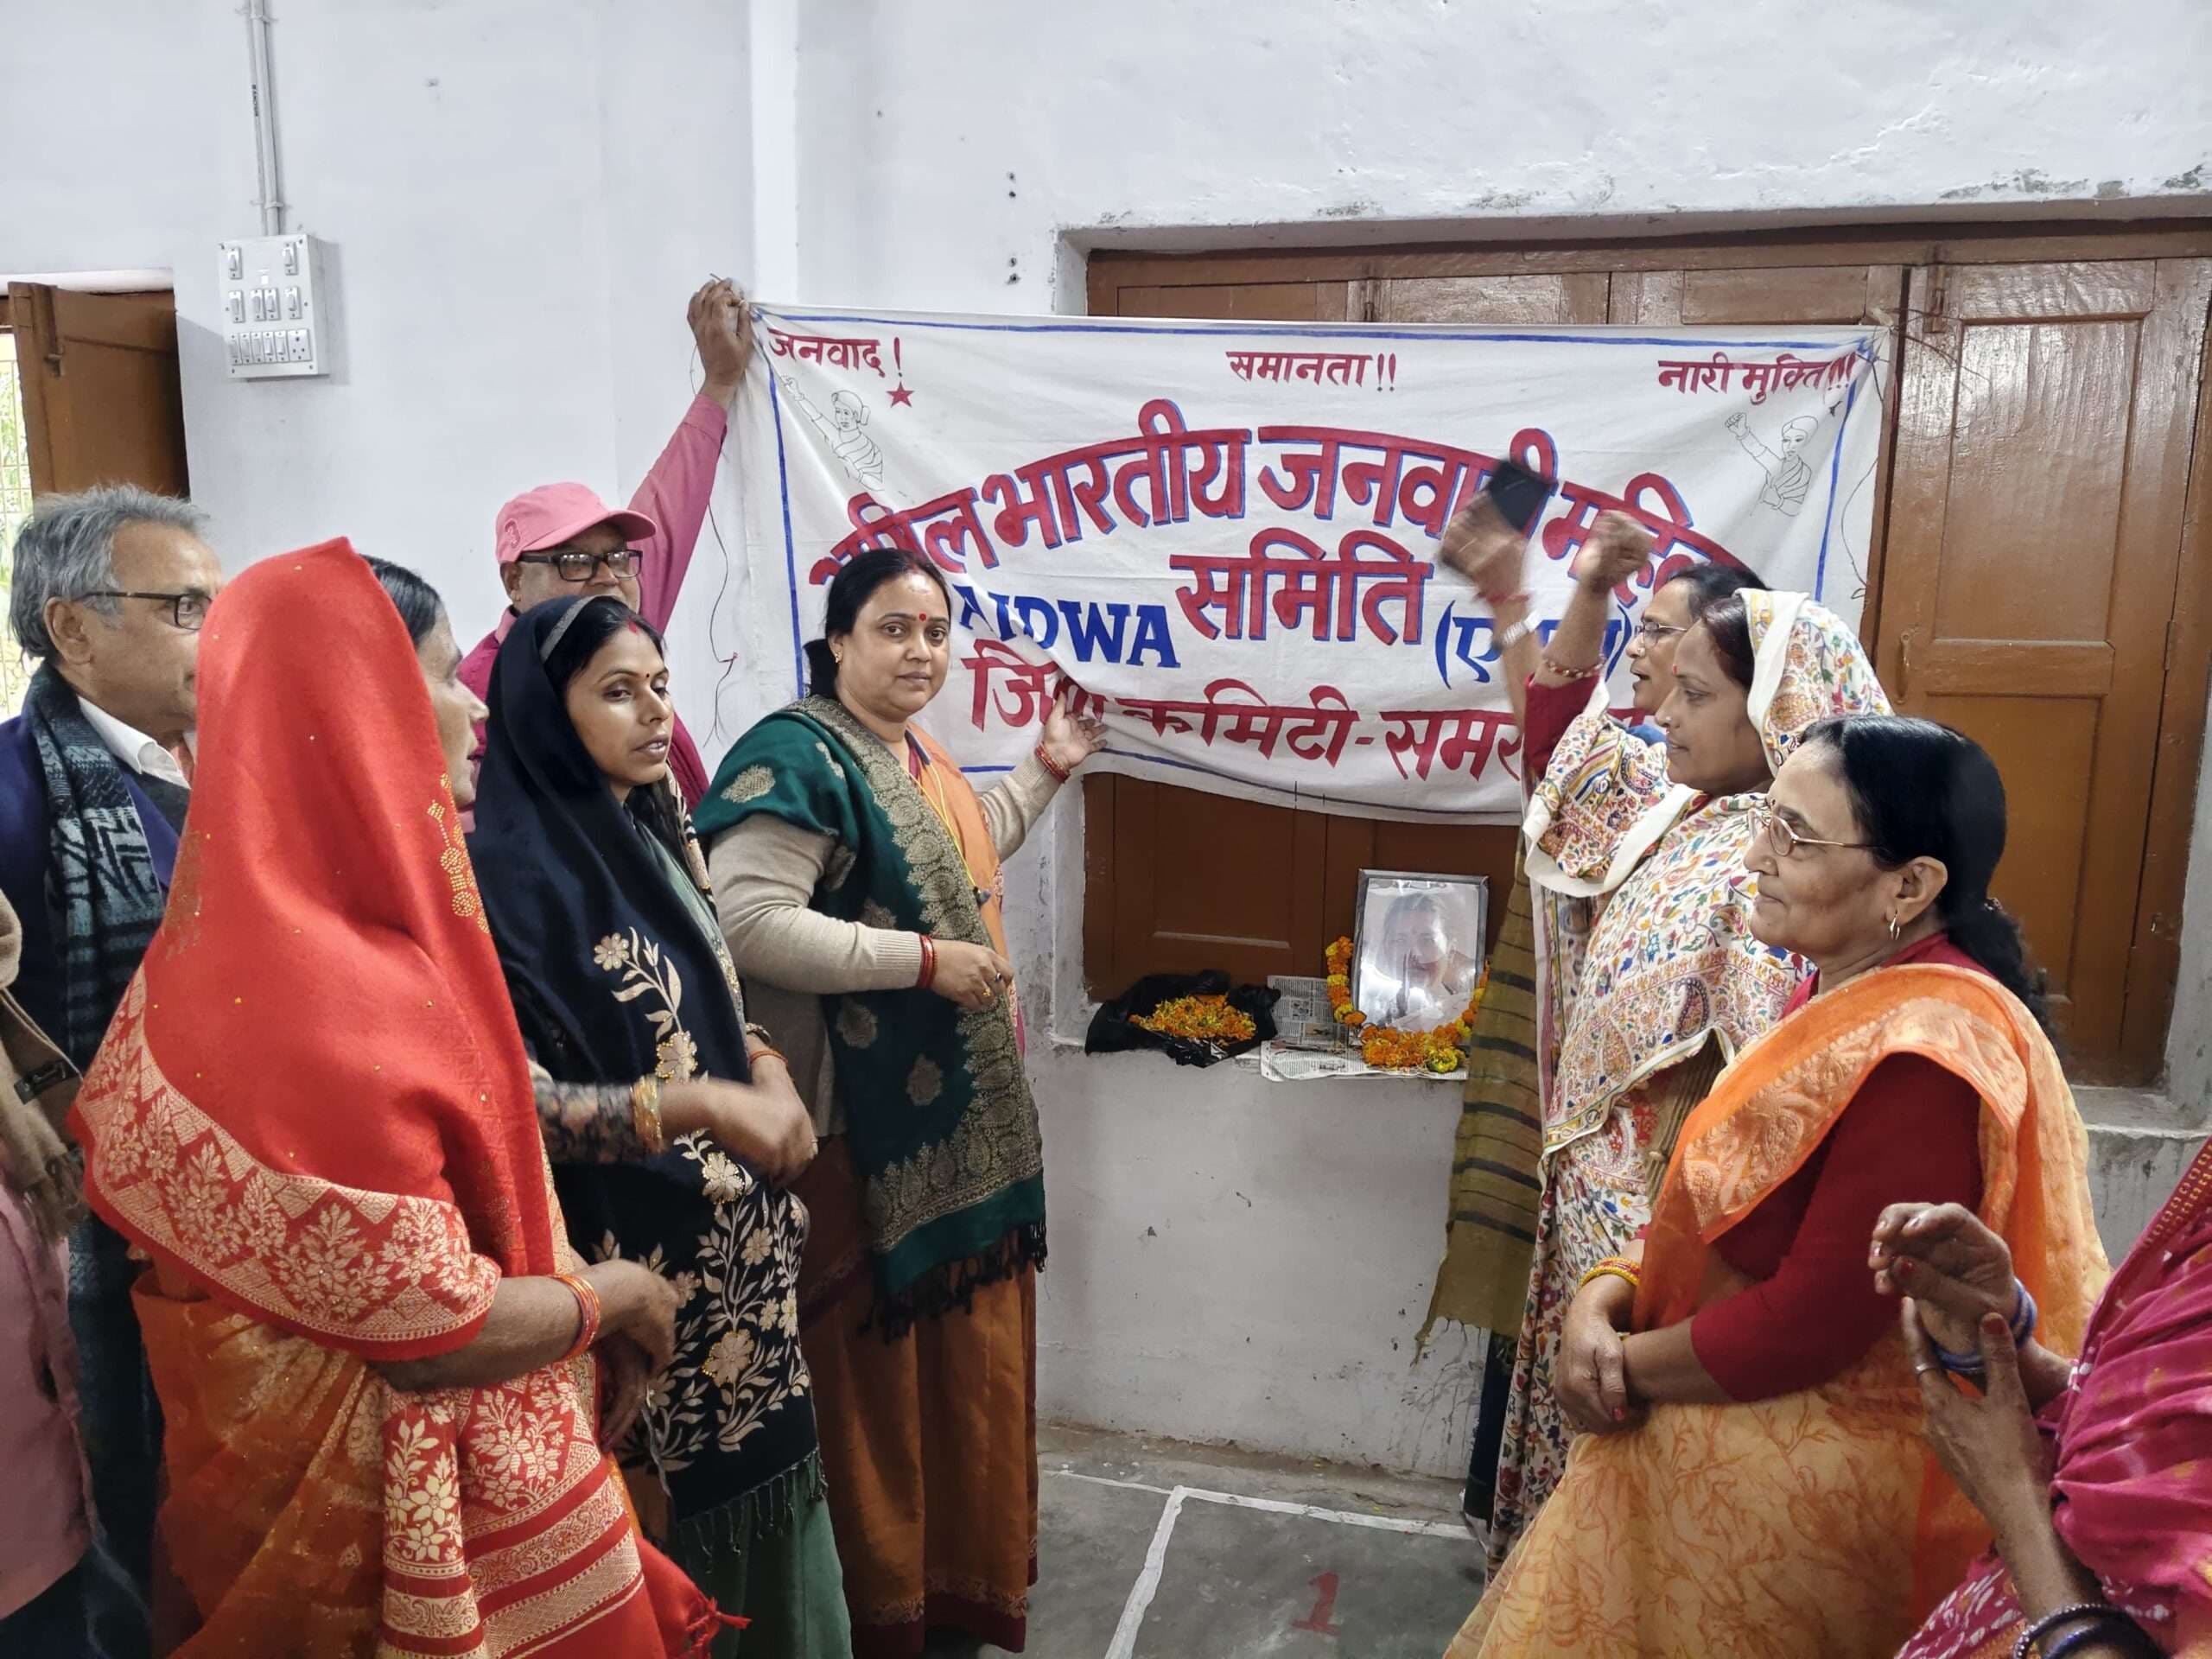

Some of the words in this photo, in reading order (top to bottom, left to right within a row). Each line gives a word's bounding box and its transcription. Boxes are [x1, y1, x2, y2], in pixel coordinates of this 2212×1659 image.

[1658, 352, 1729, 394] नारी
[982, 398, 1253, 550] भारतीय
[952, 584, 1181, 668] AIDWA
[1169, 527, 1434, 646] समिति
